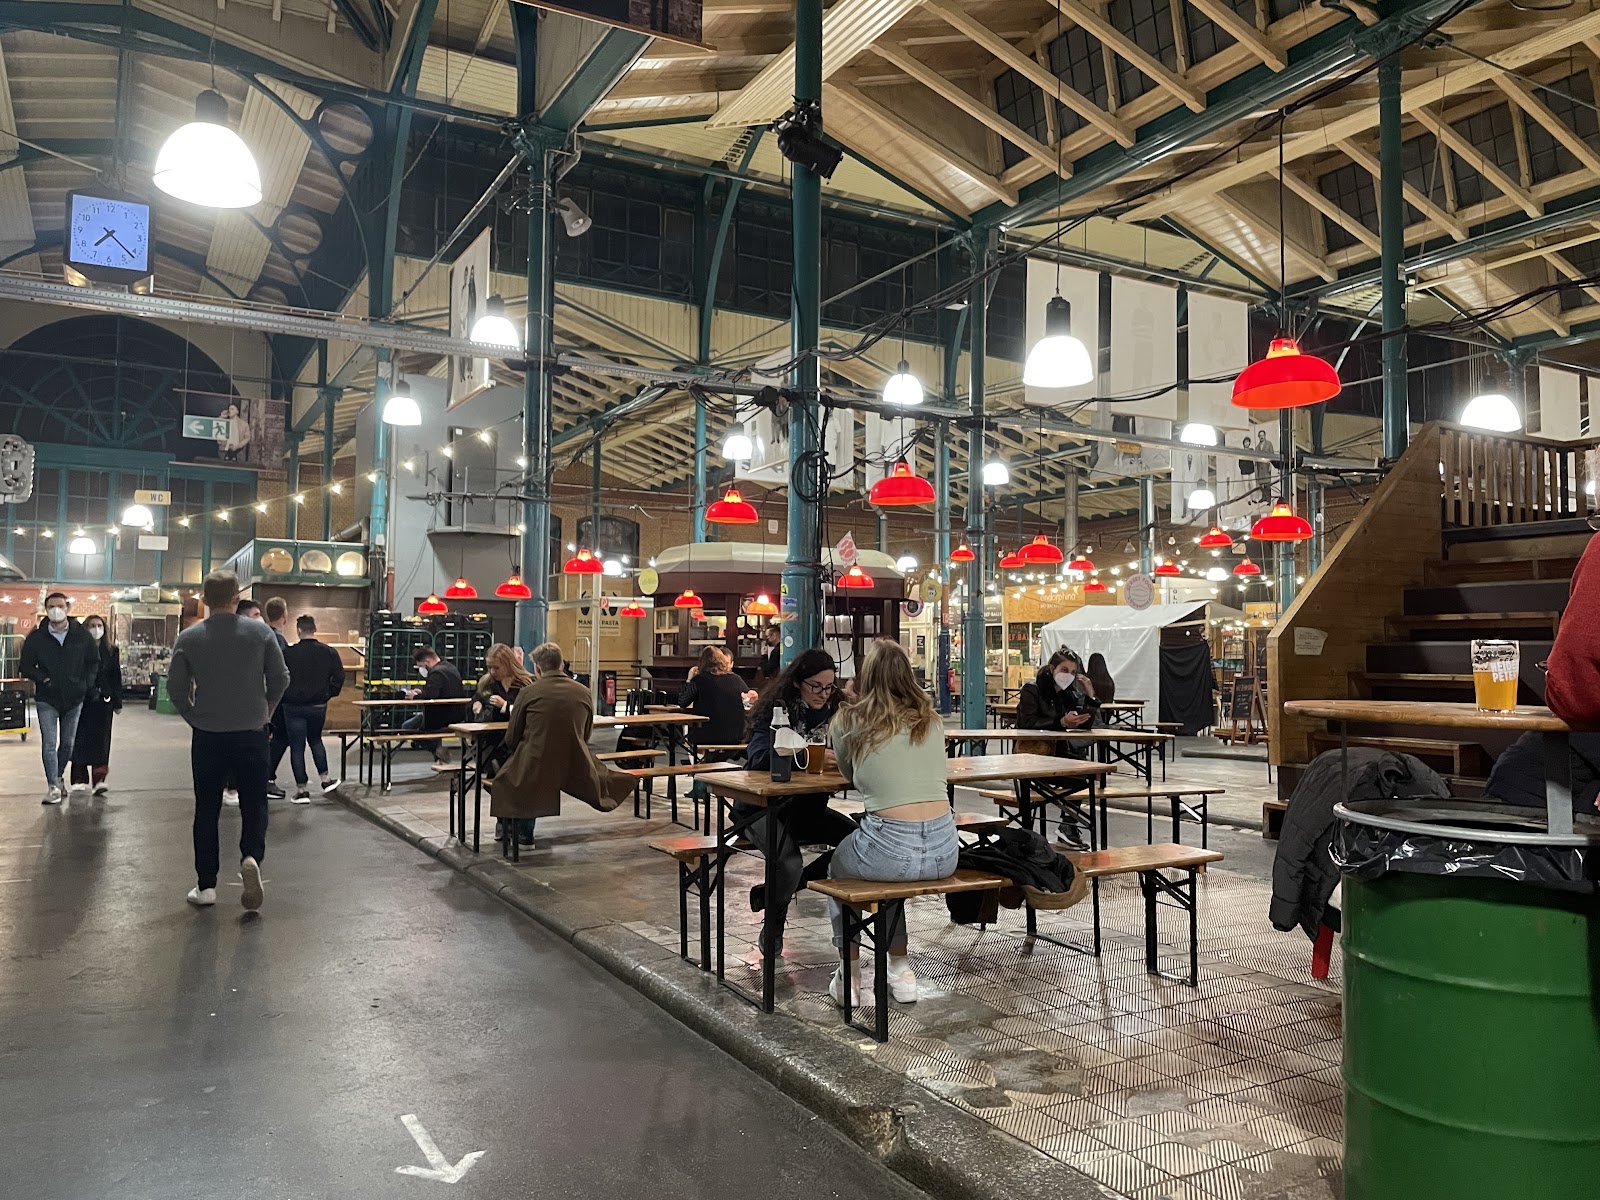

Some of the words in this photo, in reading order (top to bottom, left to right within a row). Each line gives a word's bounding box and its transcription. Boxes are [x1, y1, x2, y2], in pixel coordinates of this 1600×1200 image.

[107, 205, 115, 213] 12
[150, 493, 163, 502] WC
[1490, 660, 1518, 672] HEIDE
